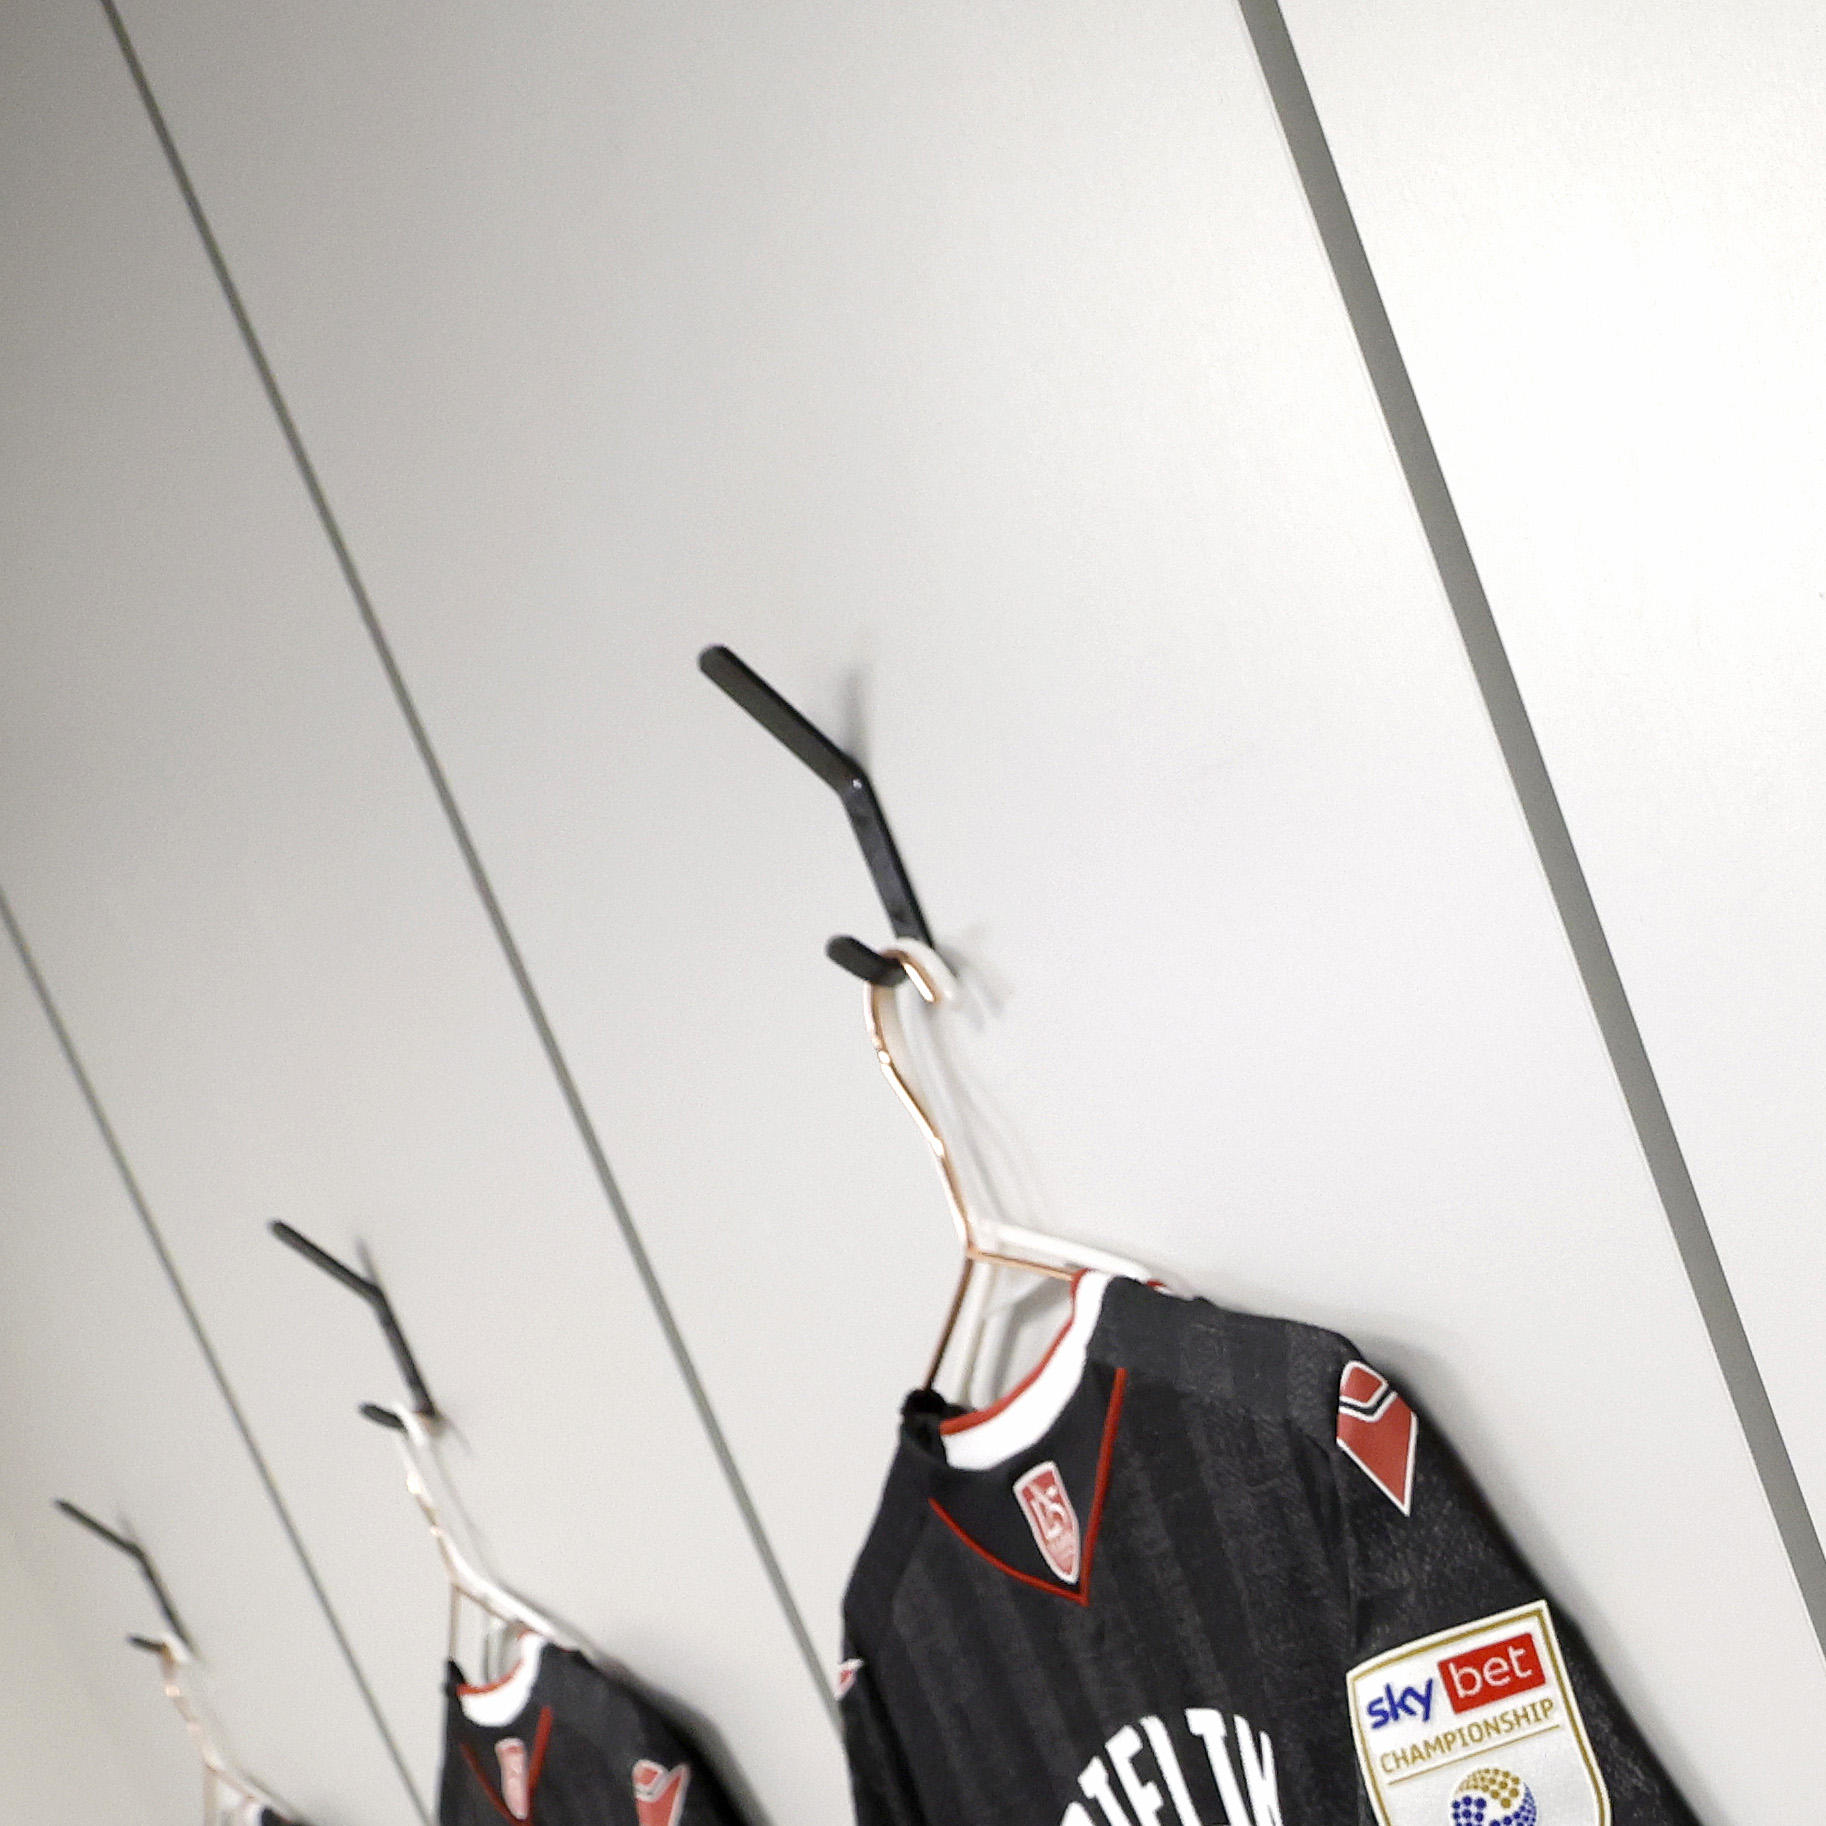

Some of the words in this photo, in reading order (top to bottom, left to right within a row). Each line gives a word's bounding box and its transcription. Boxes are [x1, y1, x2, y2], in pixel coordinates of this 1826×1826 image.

[1367, 1678, 1433, 1729] sky
[1448, 1645, 1533, 1698] bet
[1380, 1698, 1555, 1773] CHAMPIONSHIP
